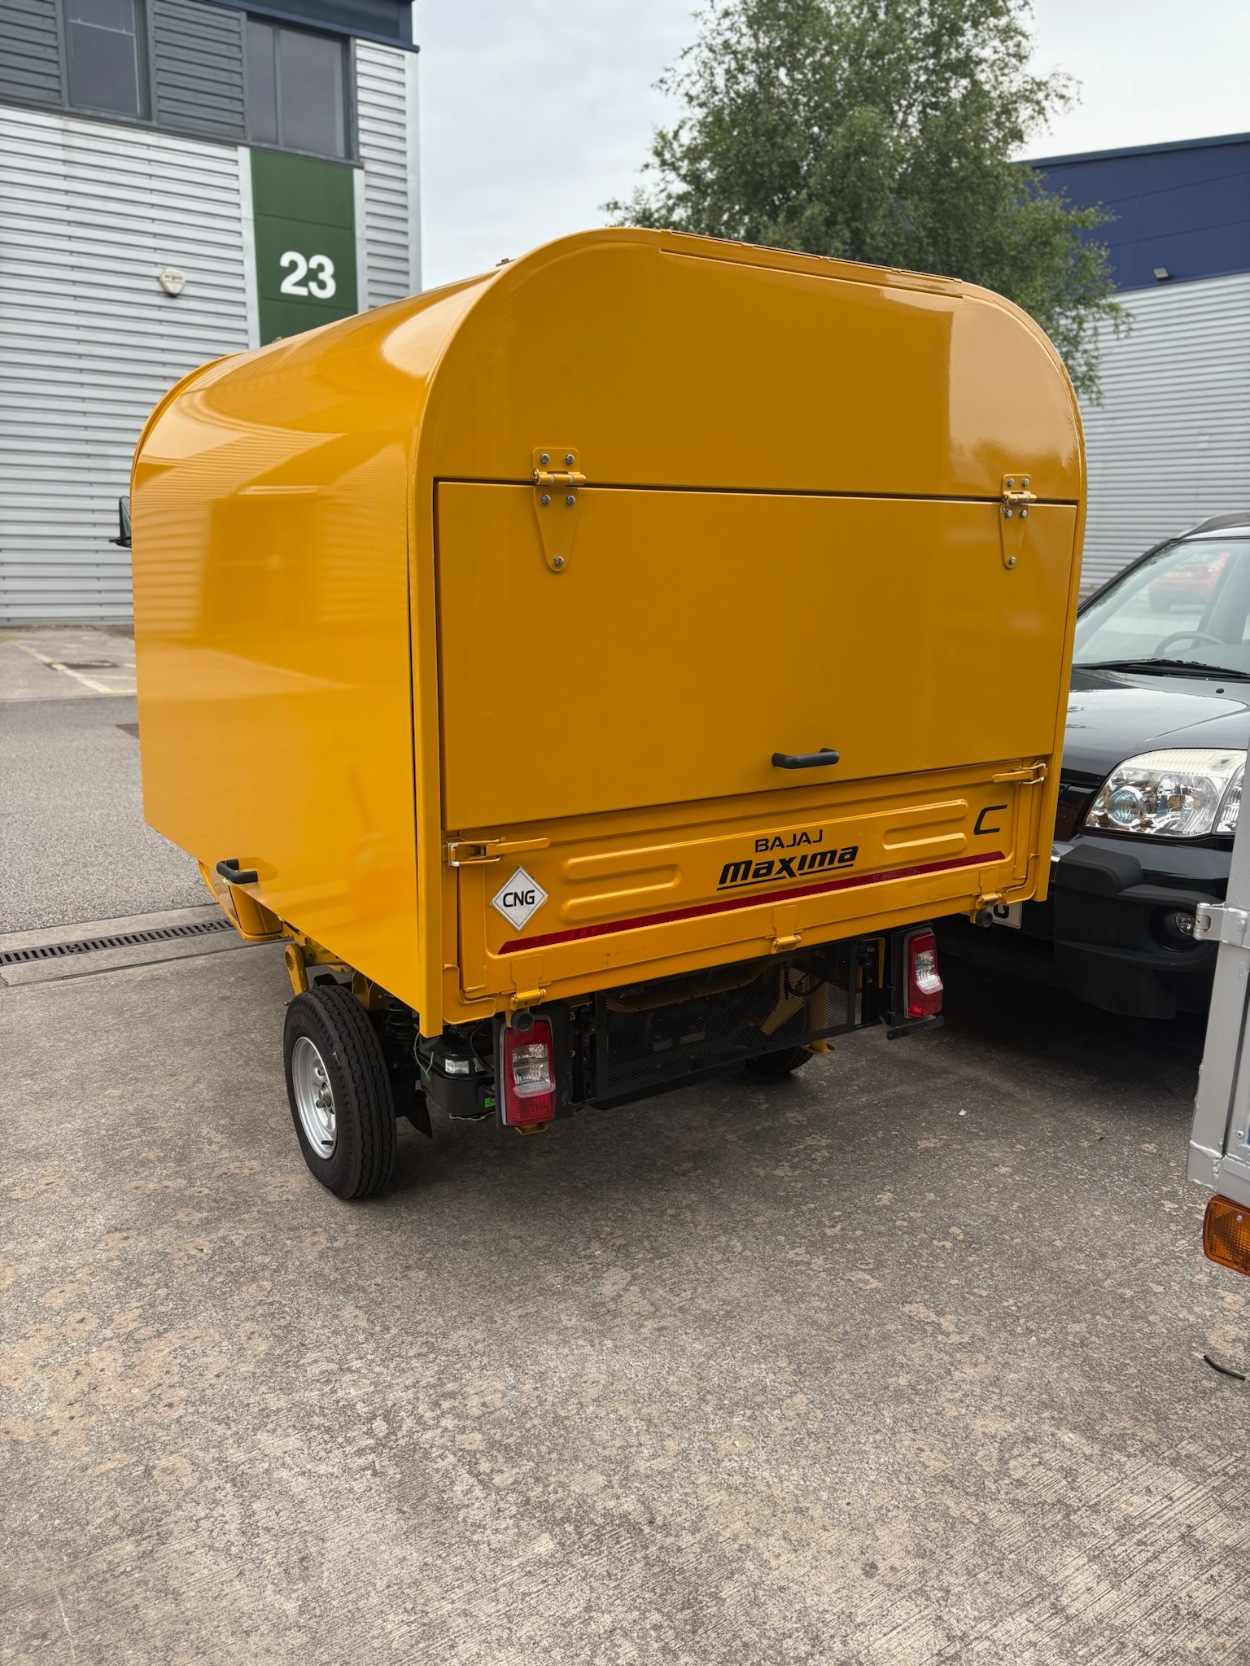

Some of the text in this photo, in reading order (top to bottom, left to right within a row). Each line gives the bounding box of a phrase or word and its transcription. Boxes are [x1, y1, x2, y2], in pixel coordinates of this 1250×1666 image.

[280, 251, 336, 299] 23
[974, 804, 1008, 835] C
[755, 829, 823, 853] BAJAJ
[503, 890, 535, 907] CNG
